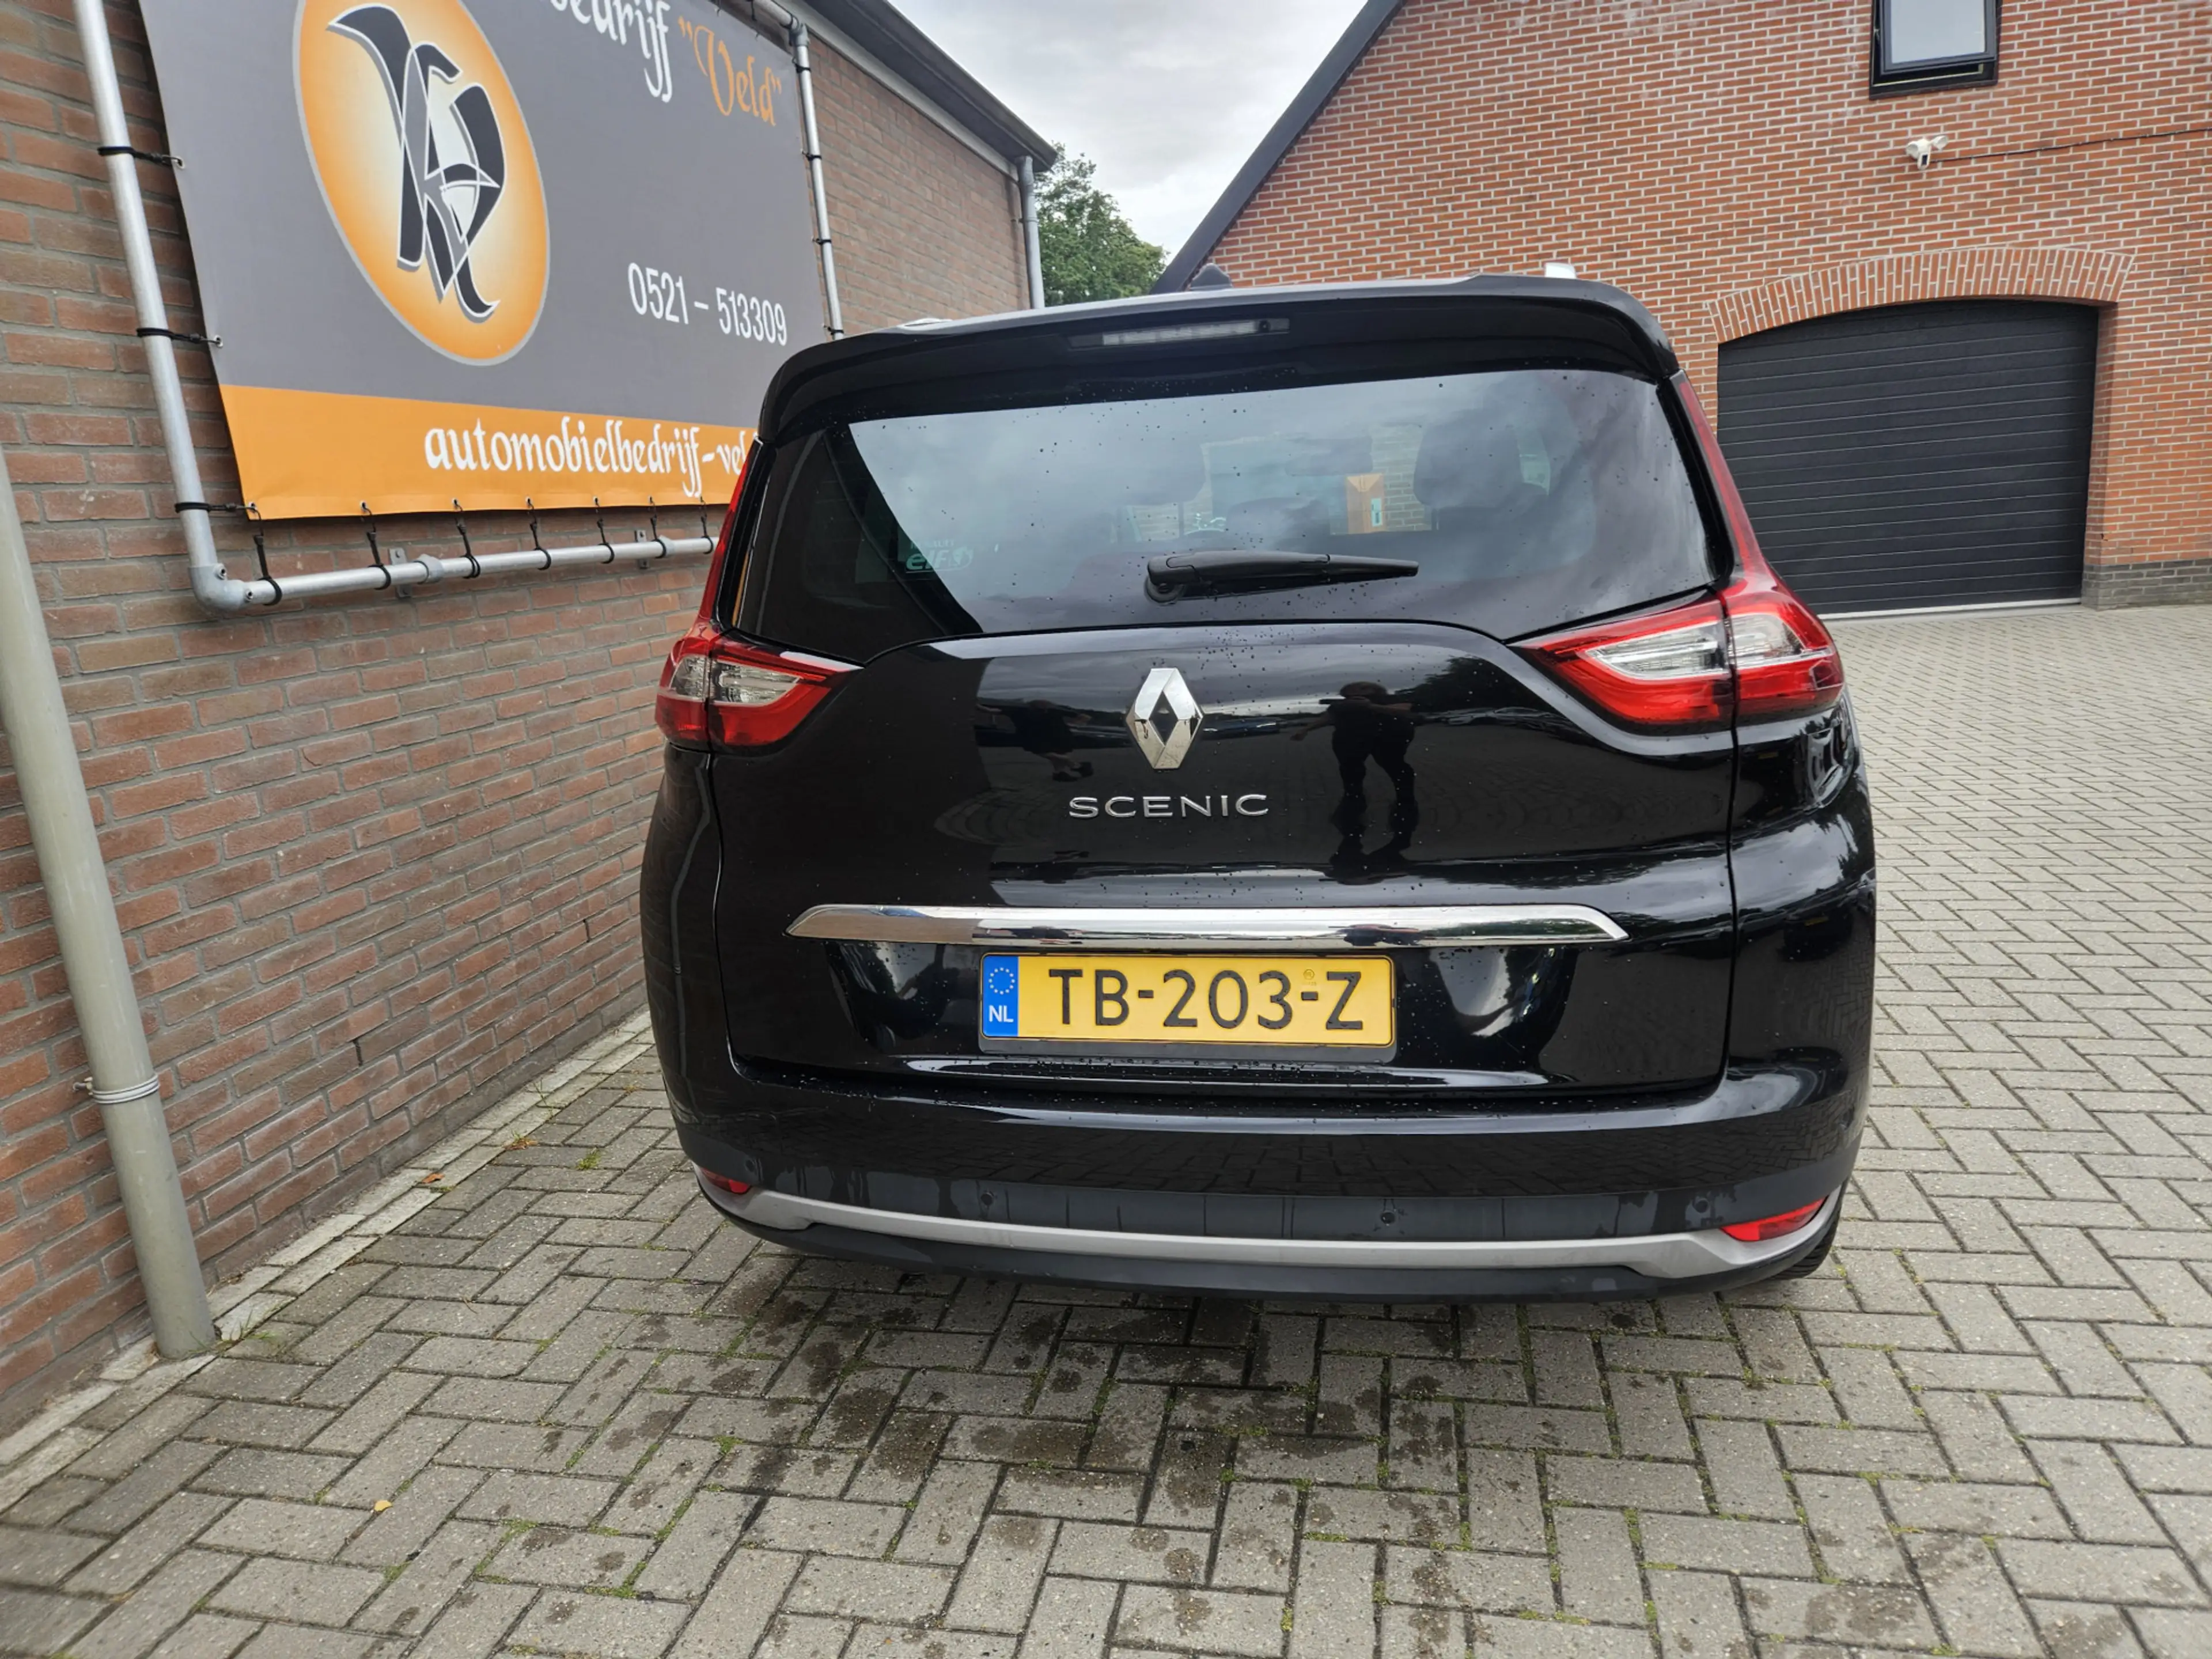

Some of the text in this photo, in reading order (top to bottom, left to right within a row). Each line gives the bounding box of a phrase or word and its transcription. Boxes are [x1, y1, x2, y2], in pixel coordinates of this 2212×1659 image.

[628, 263, 688, 324] 0521
[716, 287, 787, 346] 513309
[425, 416, 758, 498] automobielbedrijf-vel
[1069, 794, 1269, 818] SCENIC
[988, 1005, 1014, 1022] NL
[1048, 969, 1363, 1031] TB-203-Z
